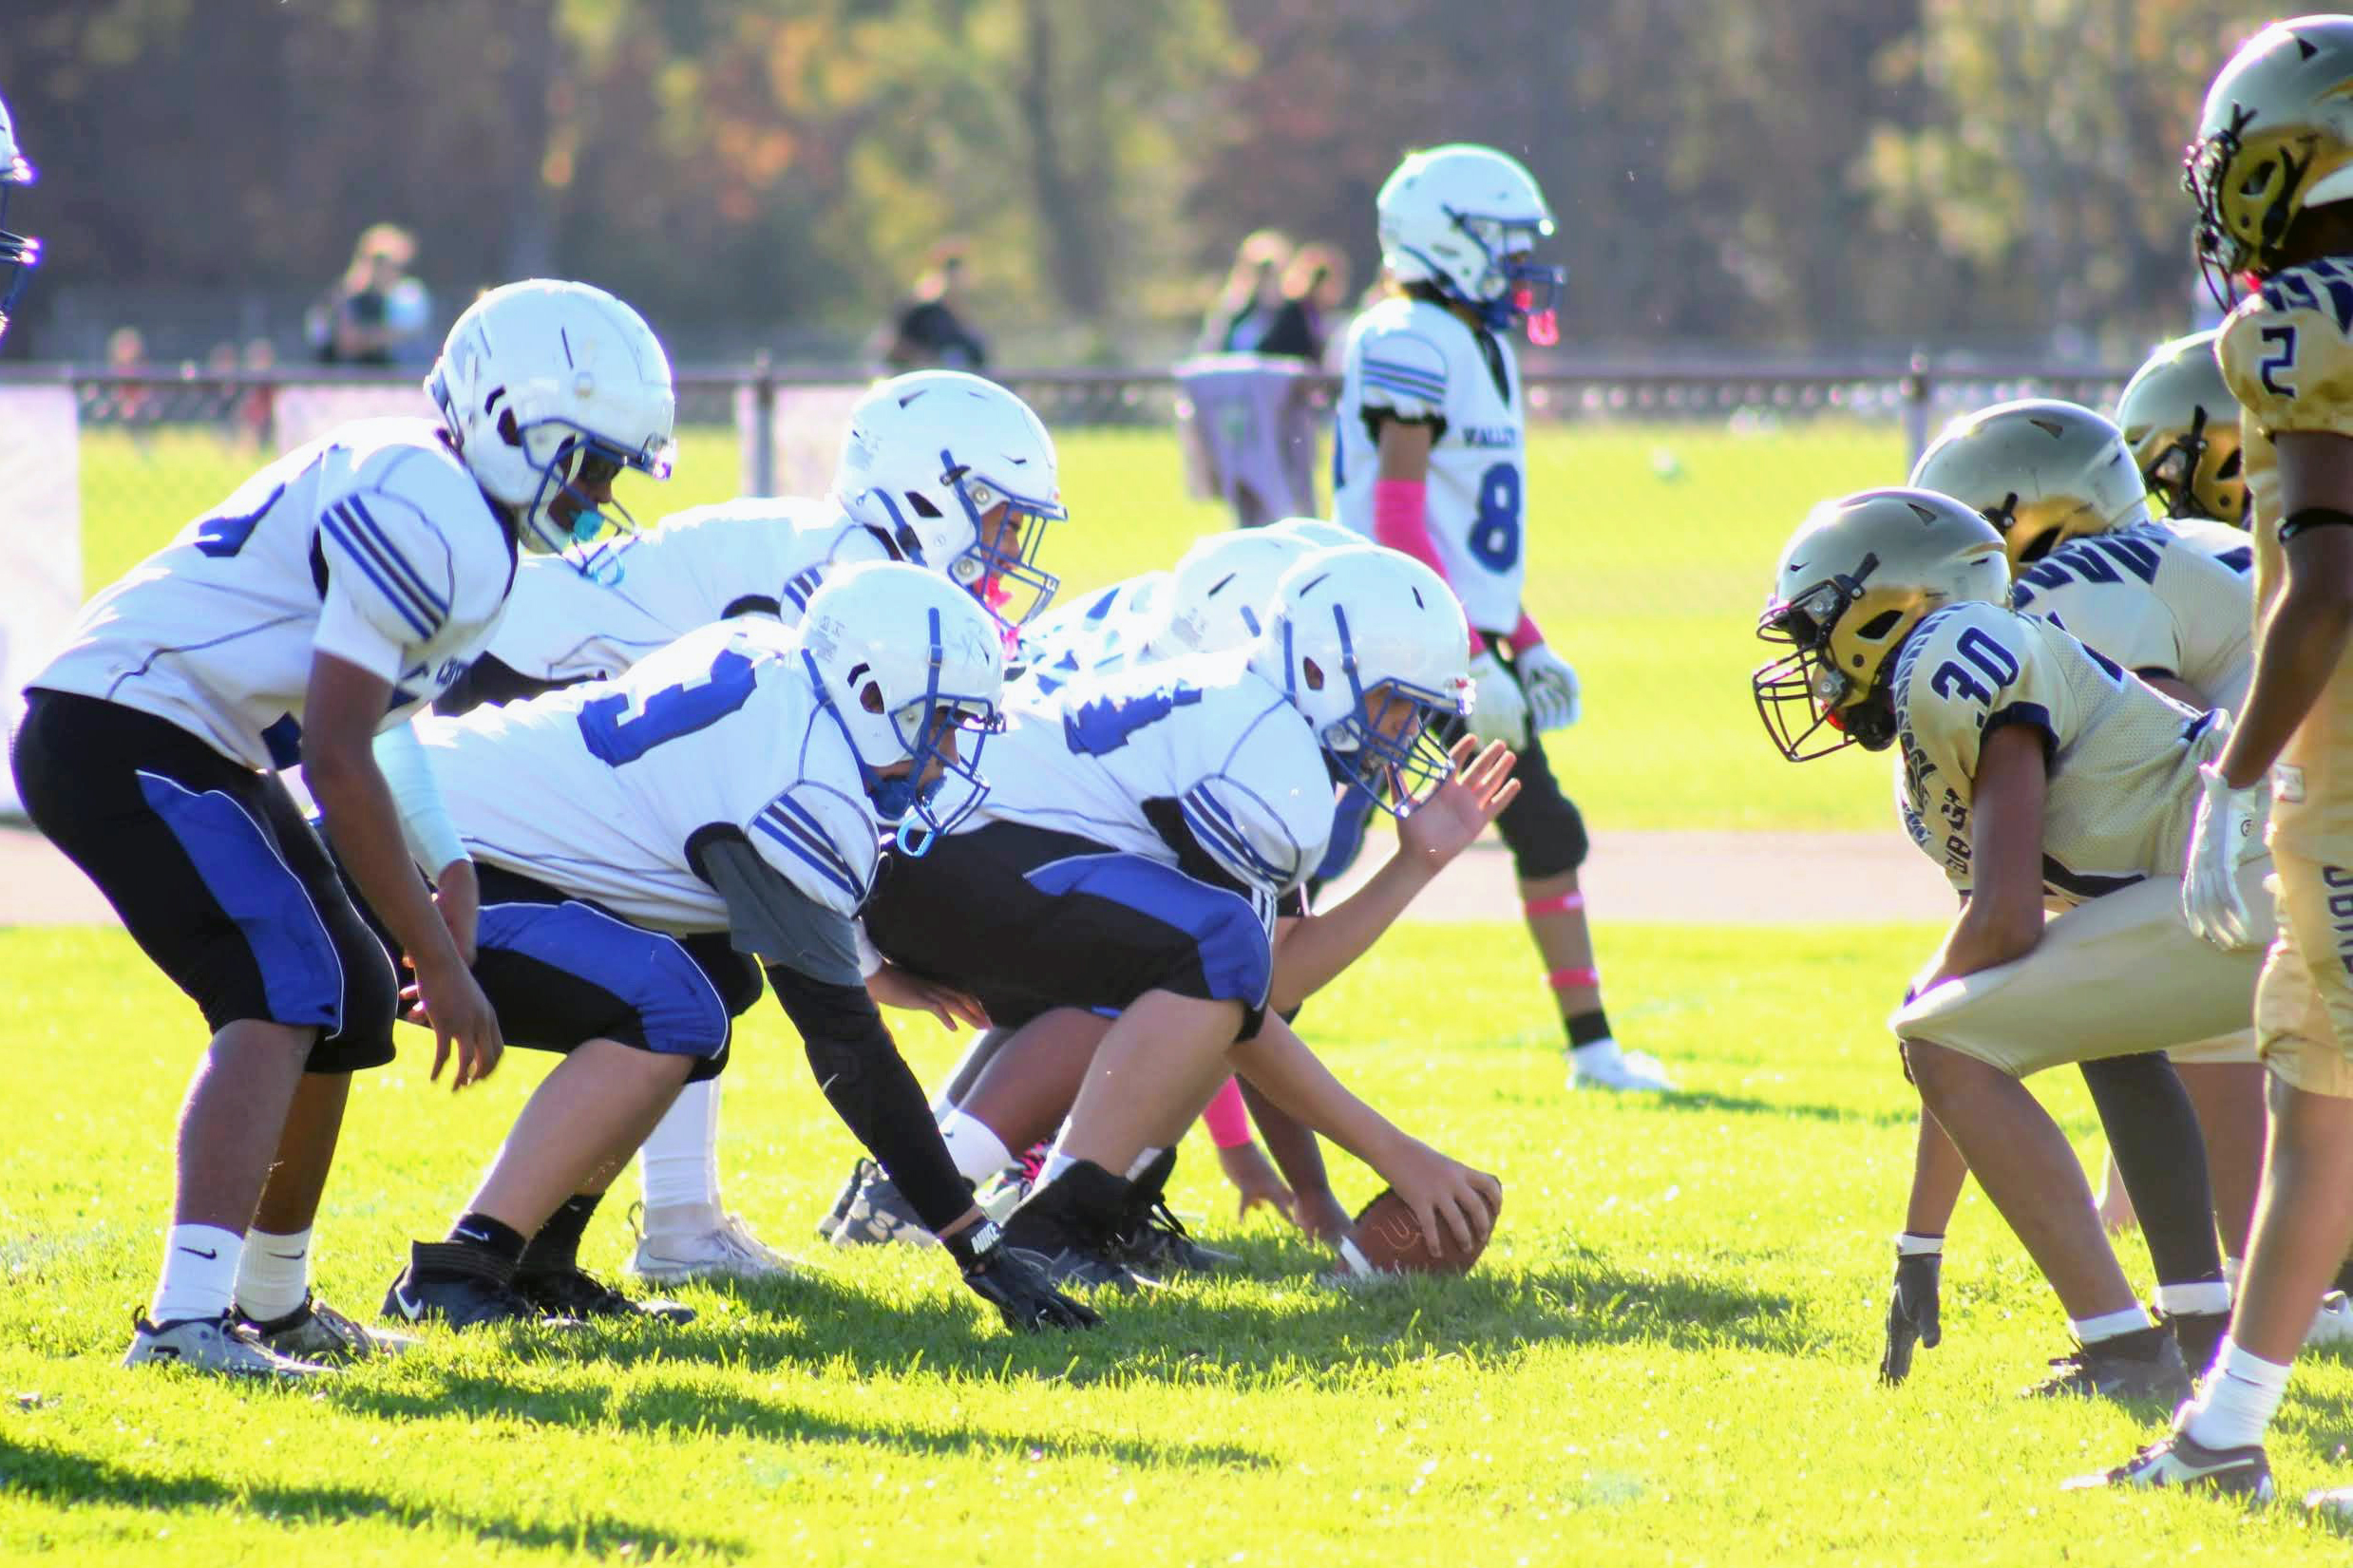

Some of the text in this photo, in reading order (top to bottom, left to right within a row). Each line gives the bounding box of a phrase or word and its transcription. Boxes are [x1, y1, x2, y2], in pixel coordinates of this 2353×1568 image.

[2260, 326, 2296, 399] 2
[1466, 462, 1520, 576] 8
[1930, 626, 2020, 729] 30
